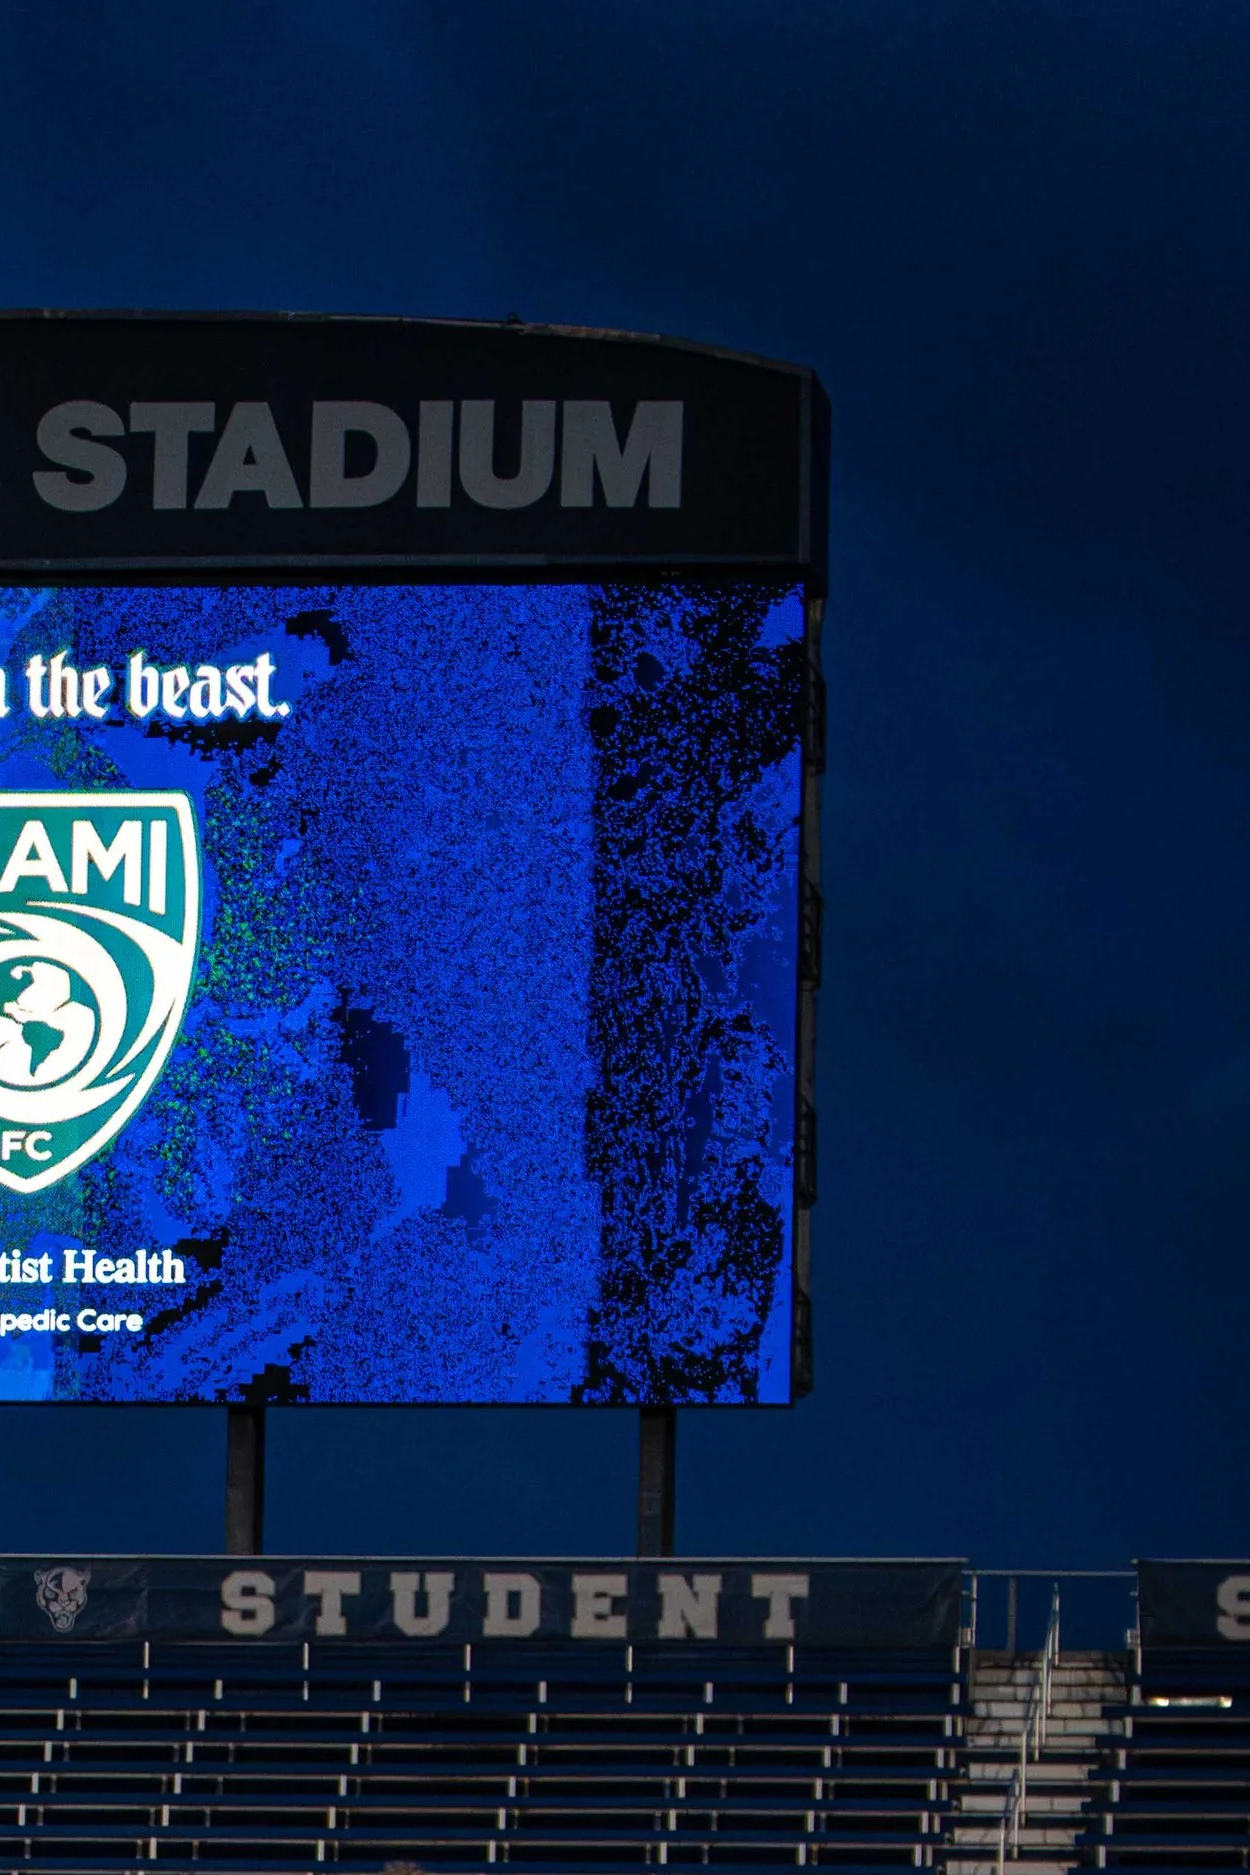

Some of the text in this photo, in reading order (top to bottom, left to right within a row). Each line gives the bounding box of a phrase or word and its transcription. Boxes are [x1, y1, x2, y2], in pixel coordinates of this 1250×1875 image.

[32, 400, 684, 511] STADIUM
[25, 650, 111, 720] the
[126, 650, 291, 720] beast.
[0, 1131, 53, 1162] FC
[62, 1249, 186, 1285] Health
[75, 1310, 143, 1333] Care
[221, 1571, 810, 1641] STUDENT
